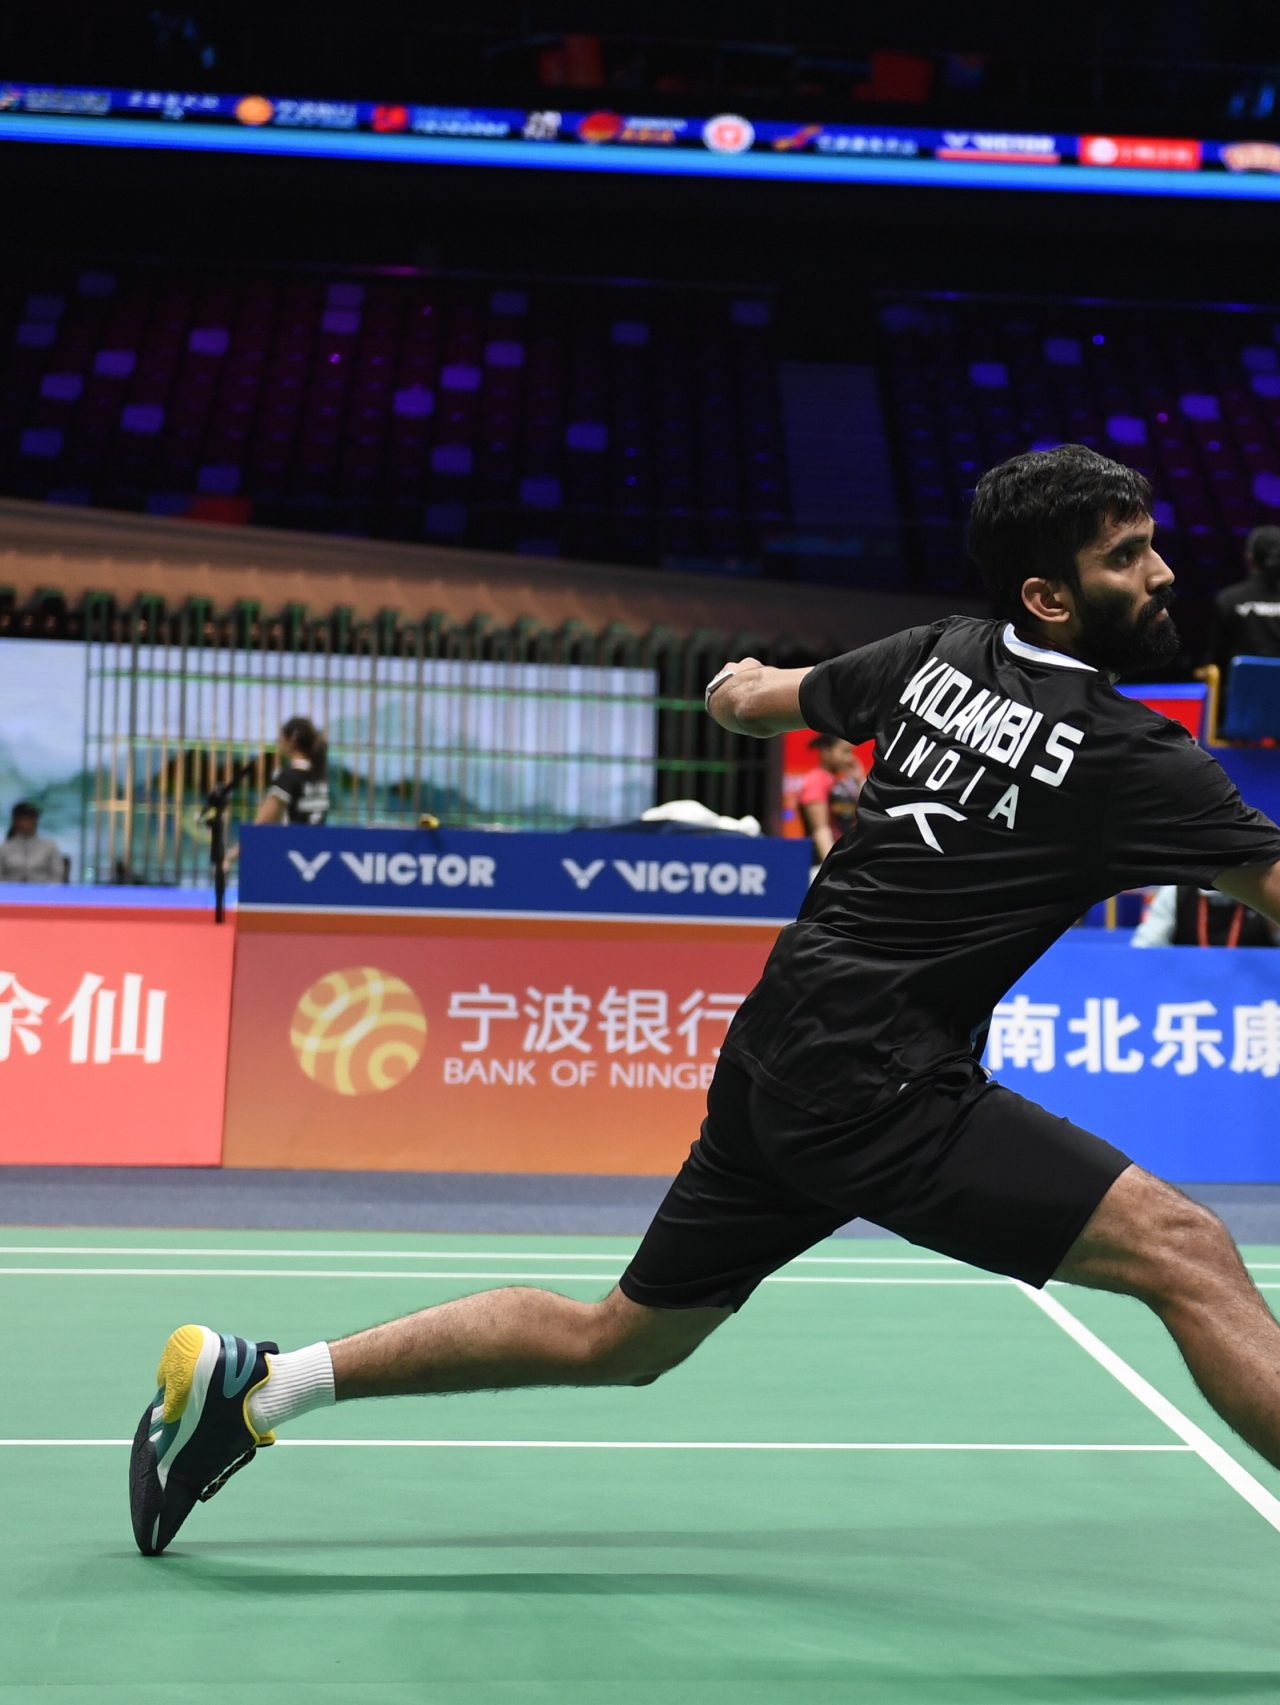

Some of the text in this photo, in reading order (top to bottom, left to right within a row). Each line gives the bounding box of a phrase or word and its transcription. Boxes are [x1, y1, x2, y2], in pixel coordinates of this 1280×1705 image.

[899, 656, 1085, 787] KIDAMBI S
[884, 721, 1020, 830] INDIA
[340, 851, 496, 887] VICTOR
[613, 860, 768, 896] VICTOR
[447, 983, 748, 1057] 宁波银行
[443, 1057, 537, 1085] BANK
[551, 1059, 598, 1087] OF
